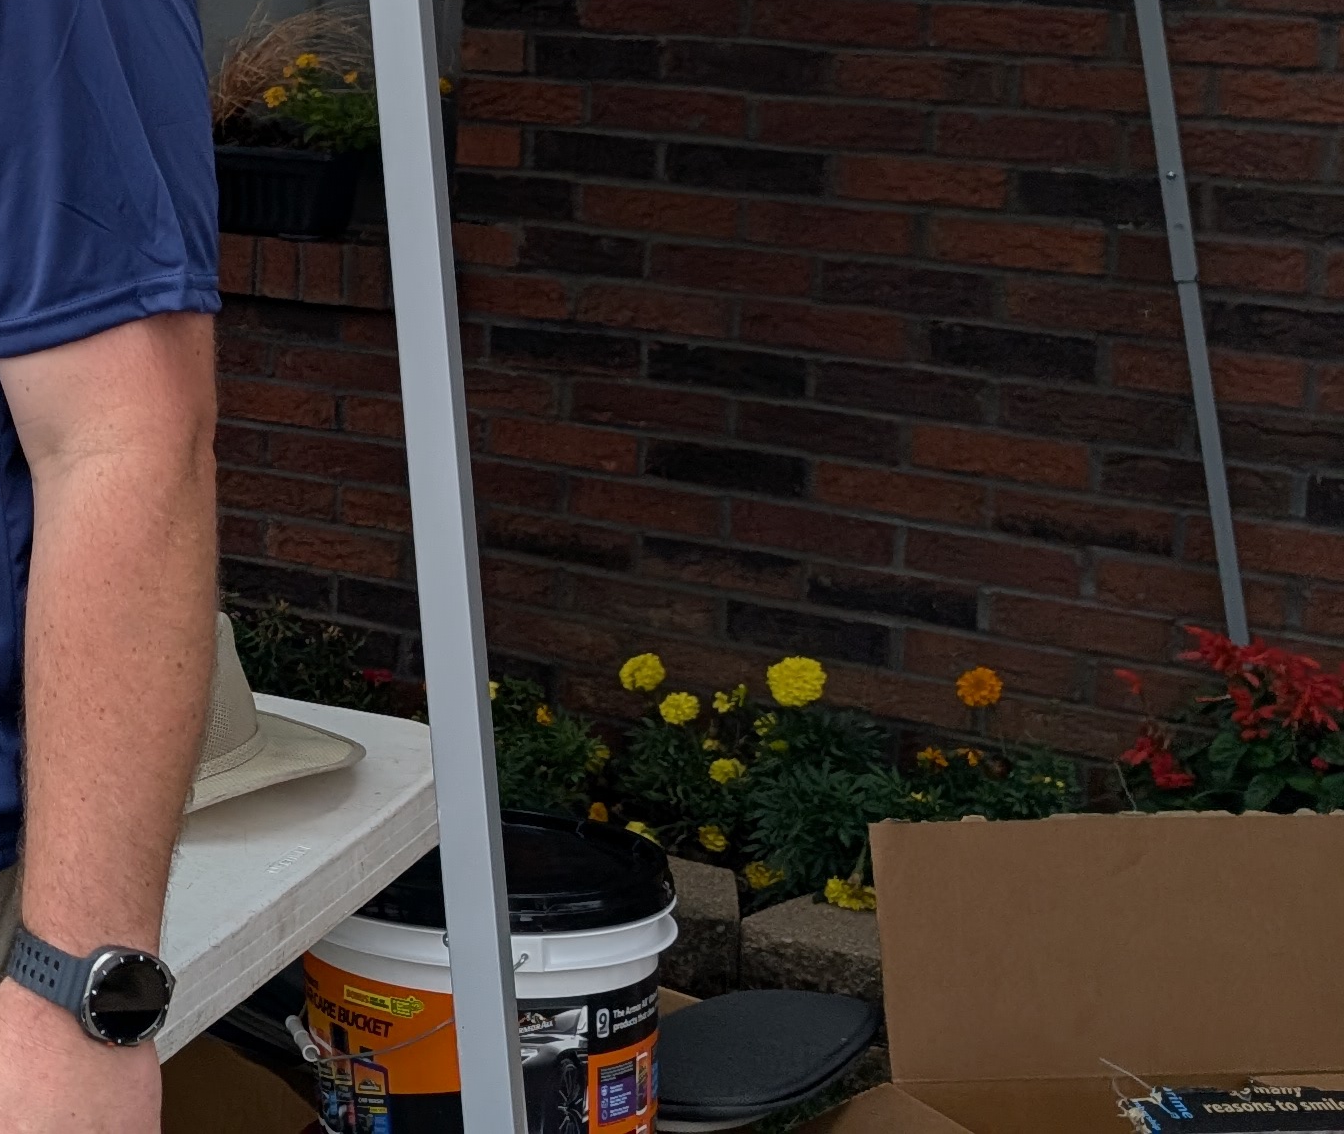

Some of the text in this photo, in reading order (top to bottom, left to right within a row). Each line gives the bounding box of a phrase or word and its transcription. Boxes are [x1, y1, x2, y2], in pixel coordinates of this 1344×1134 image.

[338, 1007, 394, 1038] BUCKET
[1202, 1100, 1276, 1114] reasons
[1275, 1099, 1299, 1112] to
